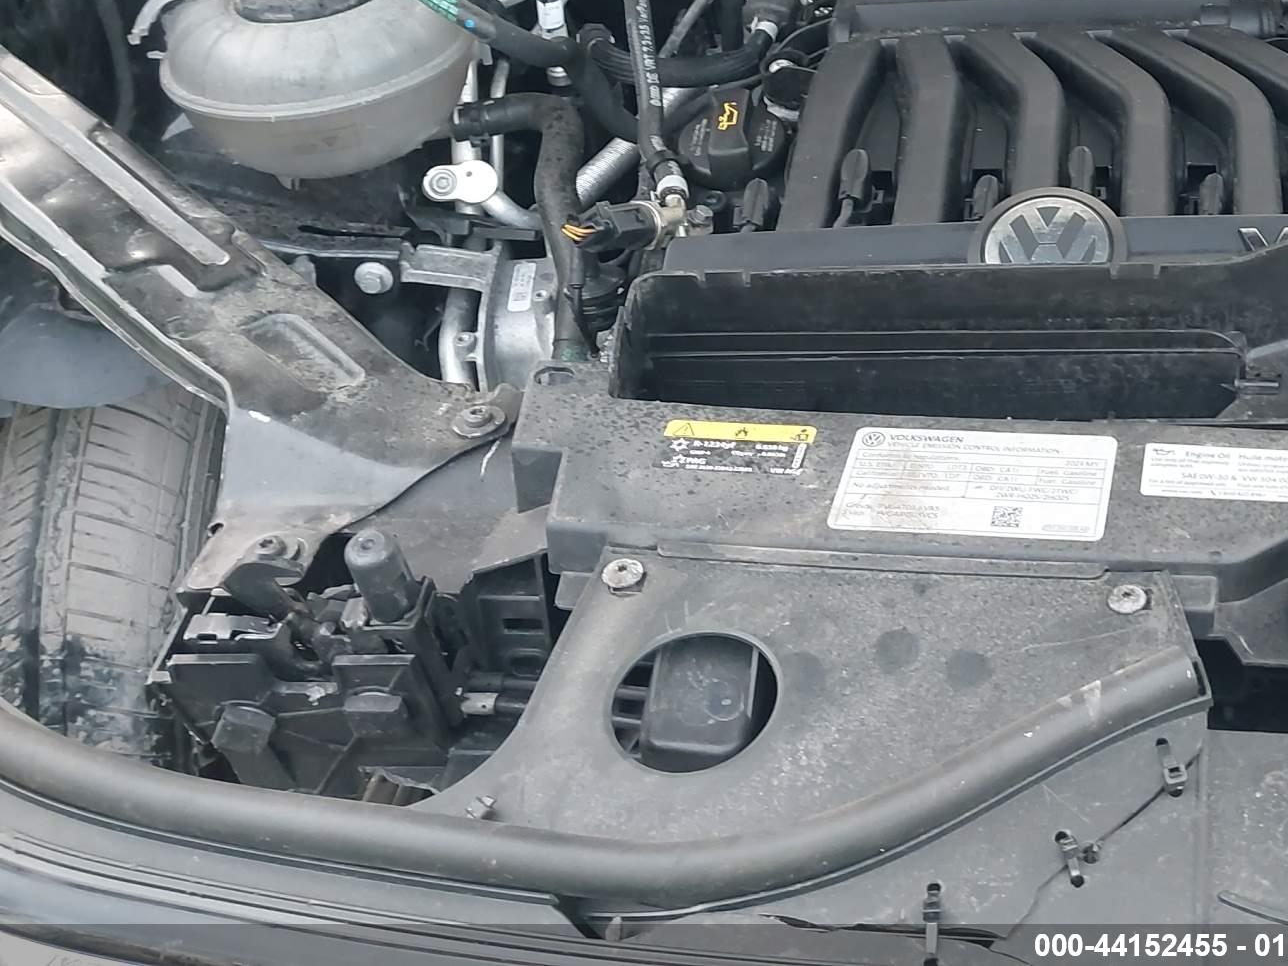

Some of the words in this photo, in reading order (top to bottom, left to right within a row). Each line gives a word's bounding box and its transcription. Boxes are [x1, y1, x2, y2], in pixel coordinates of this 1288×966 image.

[890, 434, 964, 443] VOLKSWAGEN
[963, 444, 1001, 452] CONTROL
[1185, 450, 1216, 460] Engine
[1218, 451, 1231, 459] Oil
